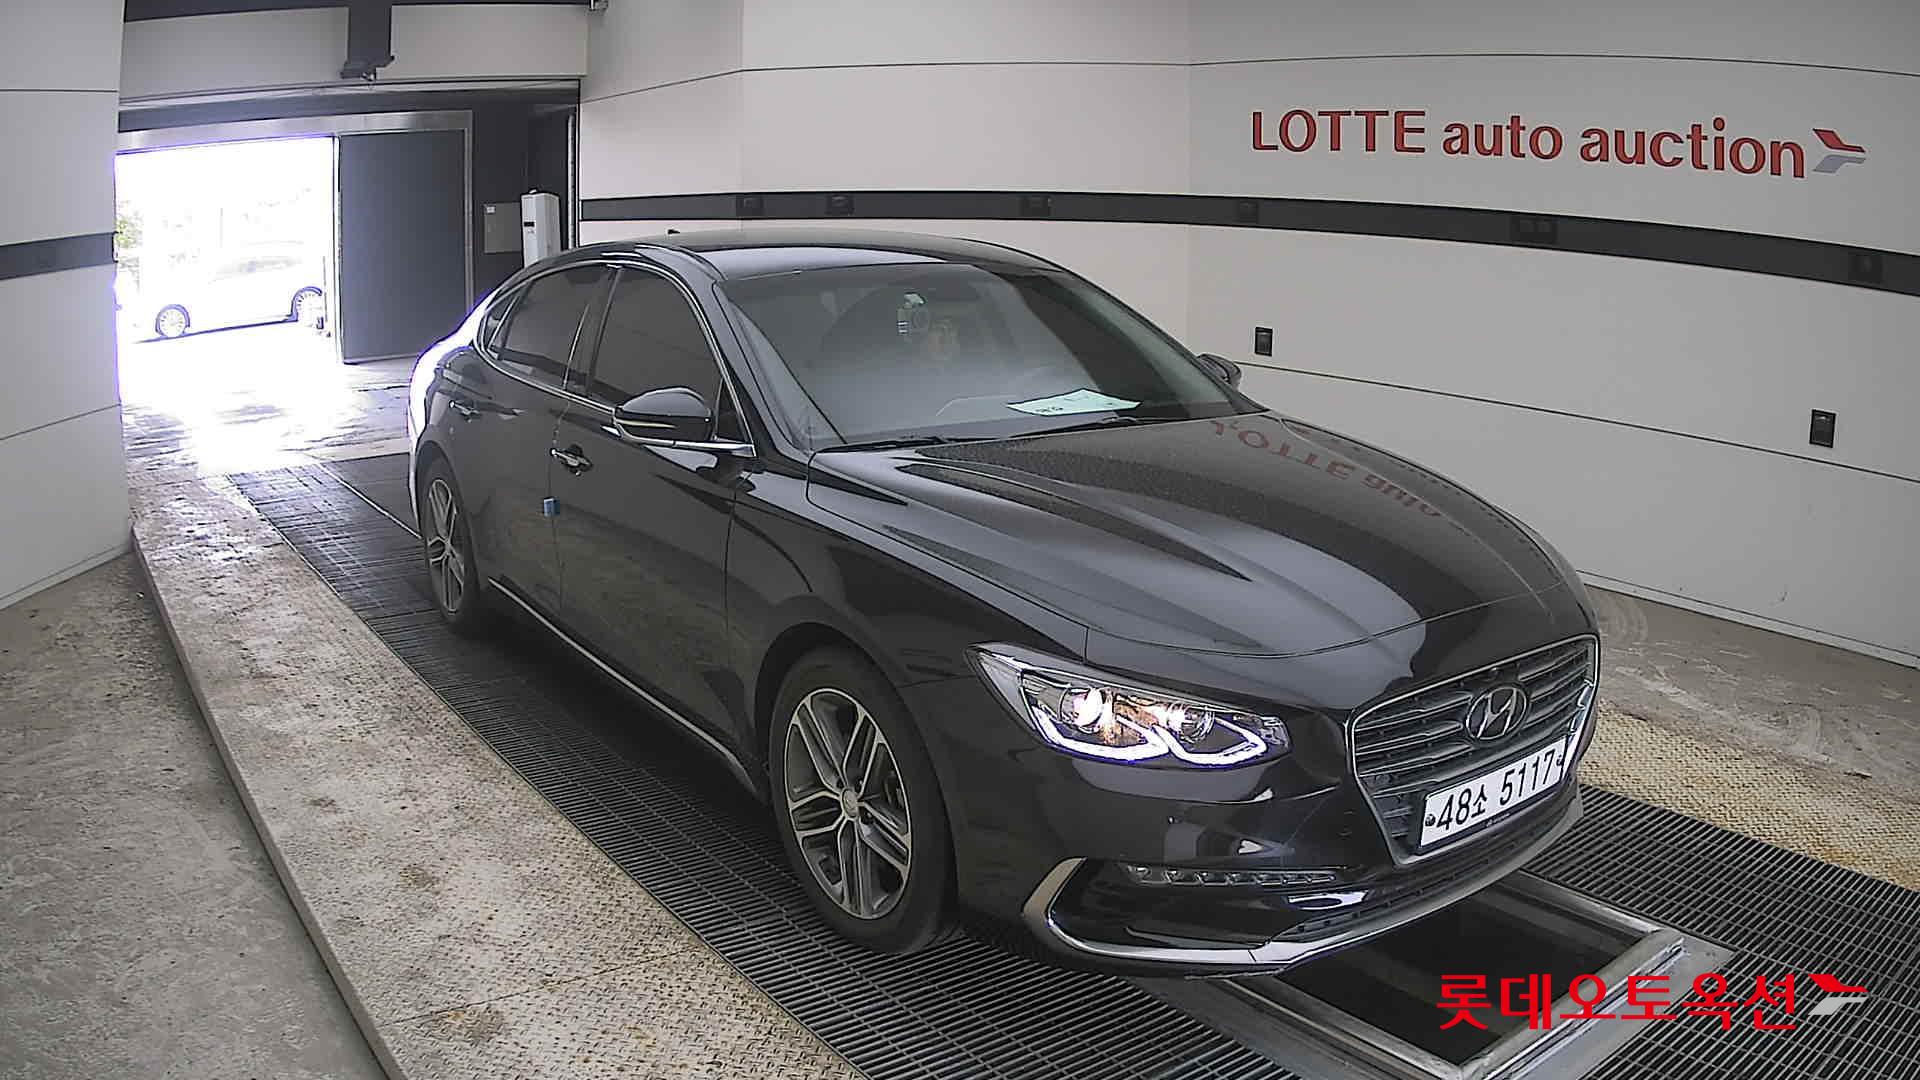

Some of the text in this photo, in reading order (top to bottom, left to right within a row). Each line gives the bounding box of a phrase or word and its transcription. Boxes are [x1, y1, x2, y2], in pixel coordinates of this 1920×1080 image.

[1251, 109, 1806, 179] LOTTE auto auction
[1436, 747, 1557, 831] 48소 5117
